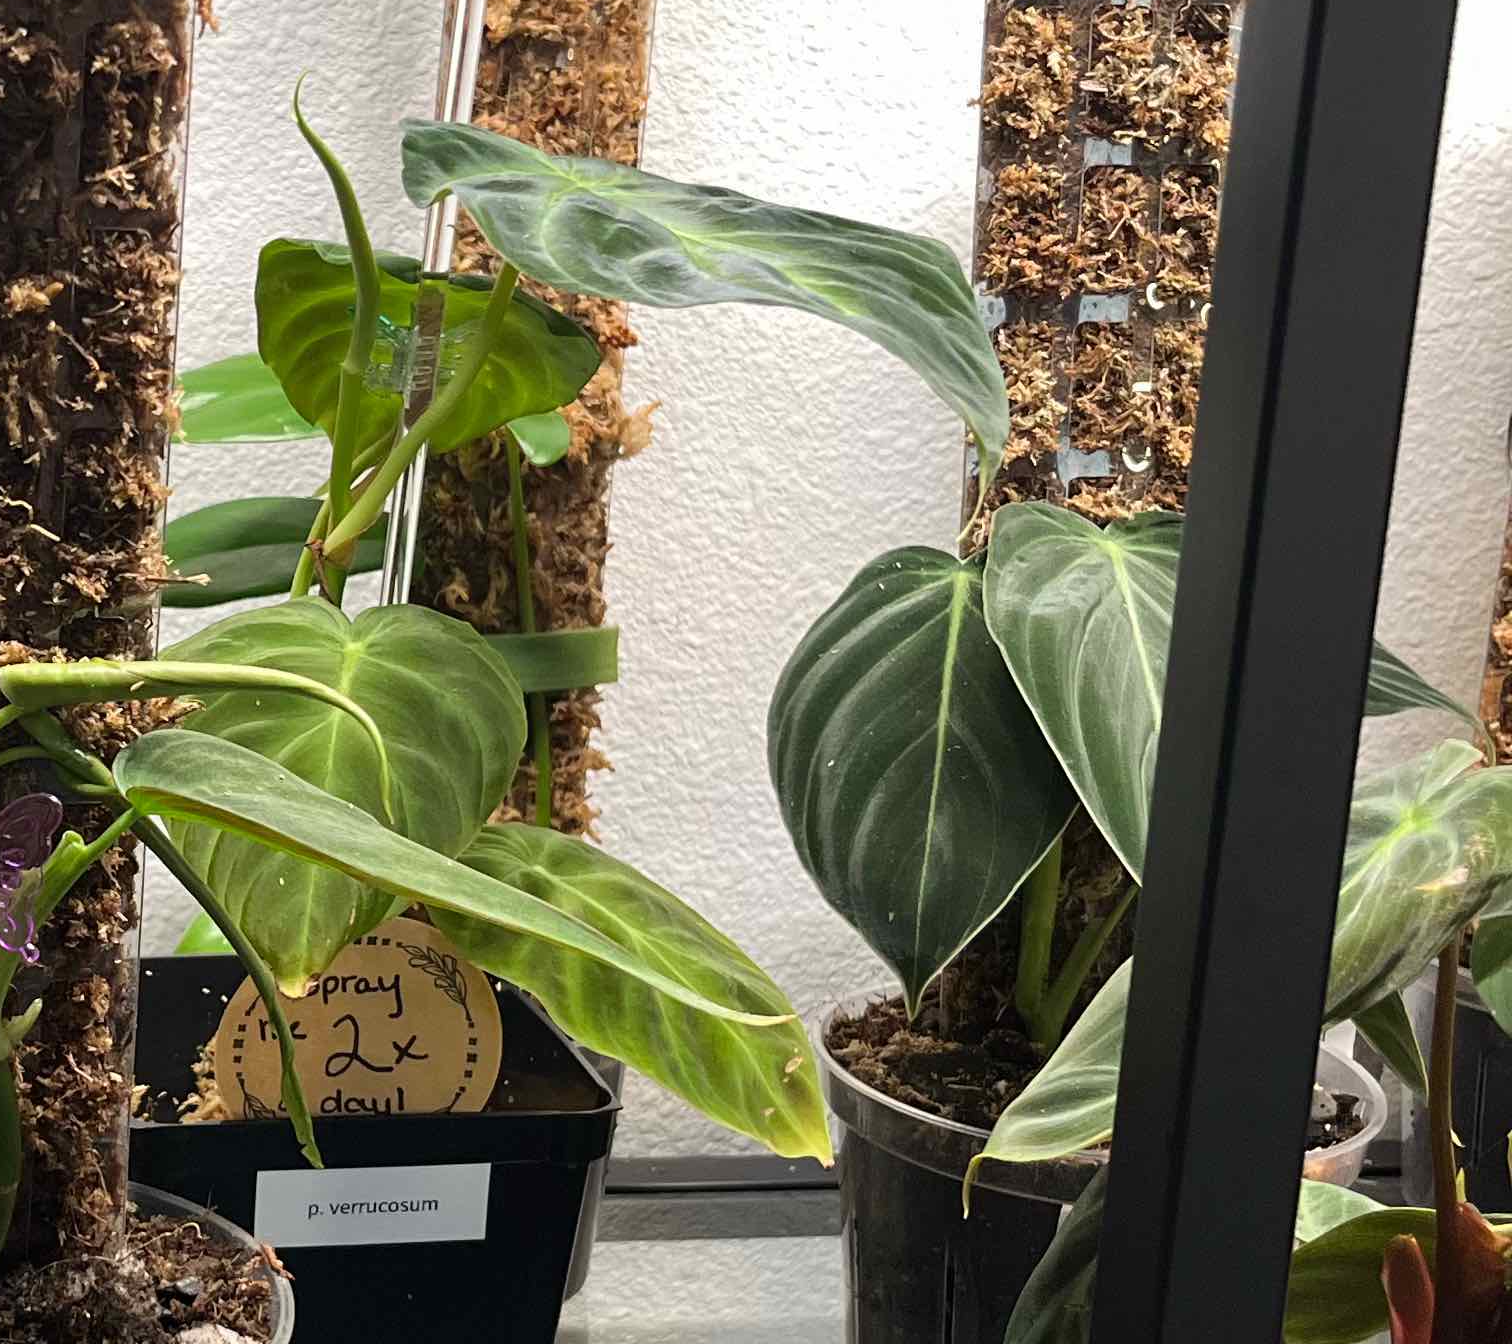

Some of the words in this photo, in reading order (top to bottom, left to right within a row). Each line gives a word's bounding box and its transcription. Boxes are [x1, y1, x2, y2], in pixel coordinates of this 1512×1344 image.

[325, 1013, 429, 1077] 2x
[307, 1202, 325, 1219] p.
[329, 1197, 440, 1216] verrucosum
